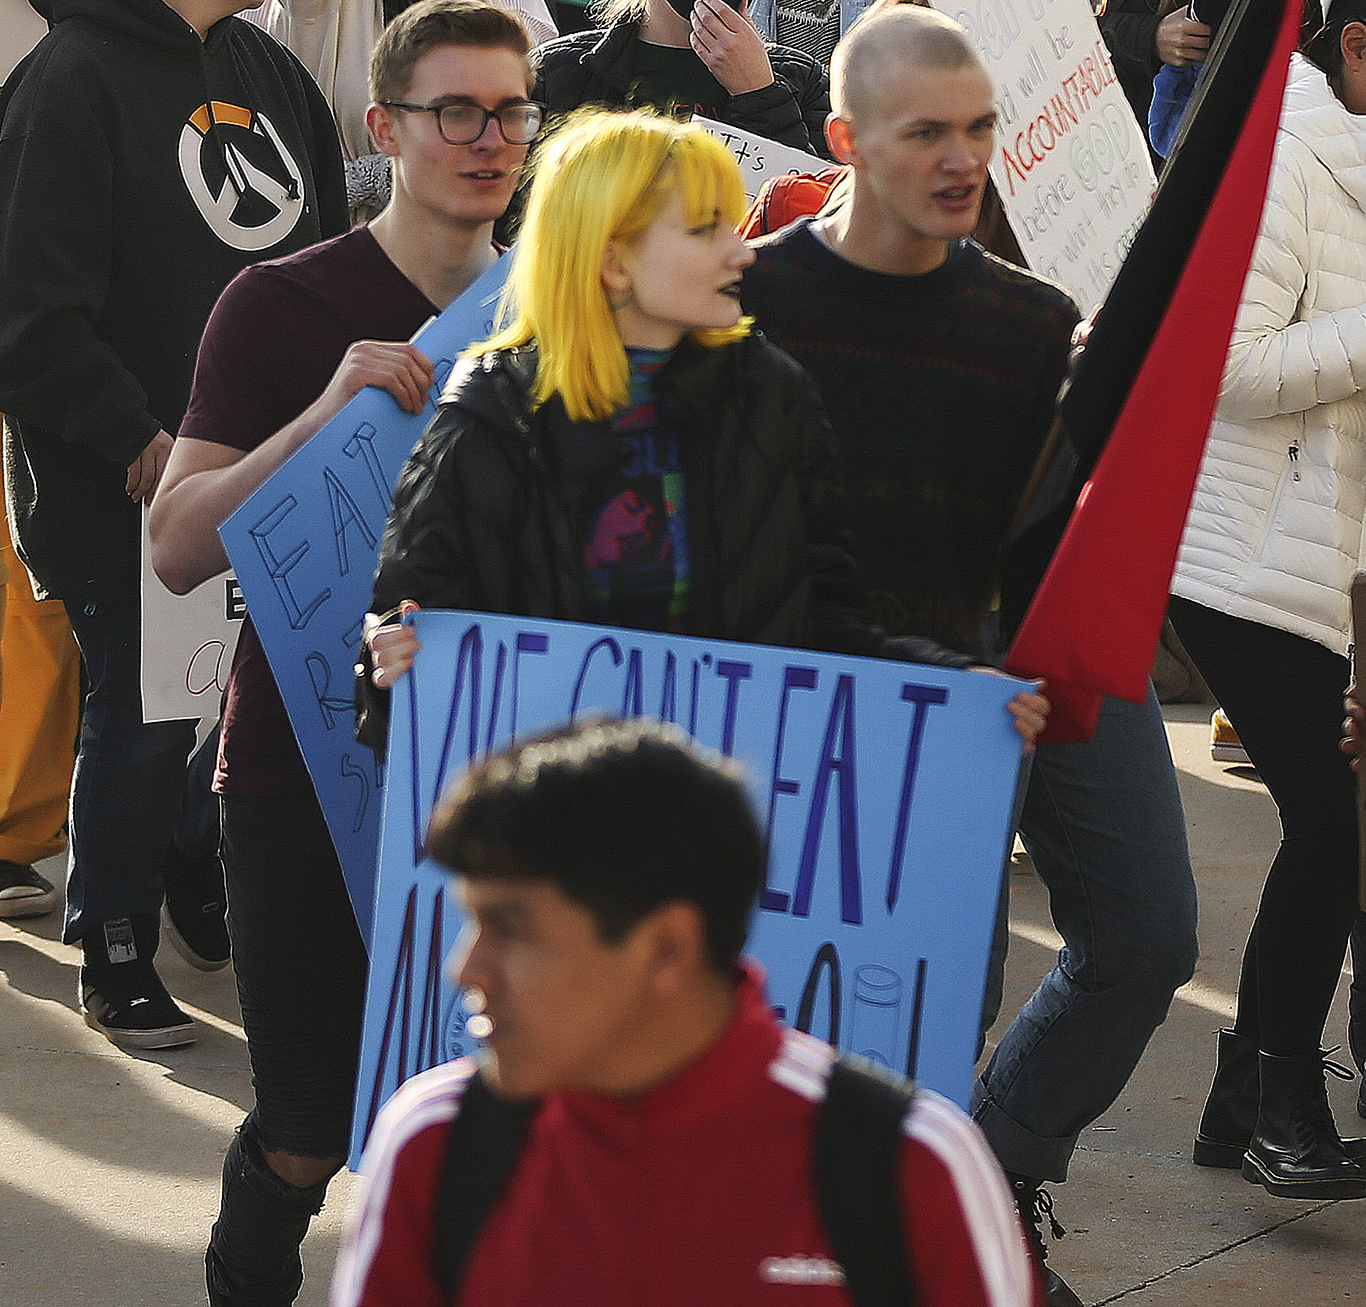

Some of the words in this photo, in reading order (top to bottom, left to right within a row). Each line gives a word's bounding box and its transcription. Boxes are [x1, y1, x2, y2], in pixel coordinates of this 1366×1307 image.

[1044, 25, 1076, 61] be
[1002, 40, 1119, 198] ACCOUNTABLE
[1068, 102, 1132, 193] GOD
[760, 664, 950, 927] EAT
